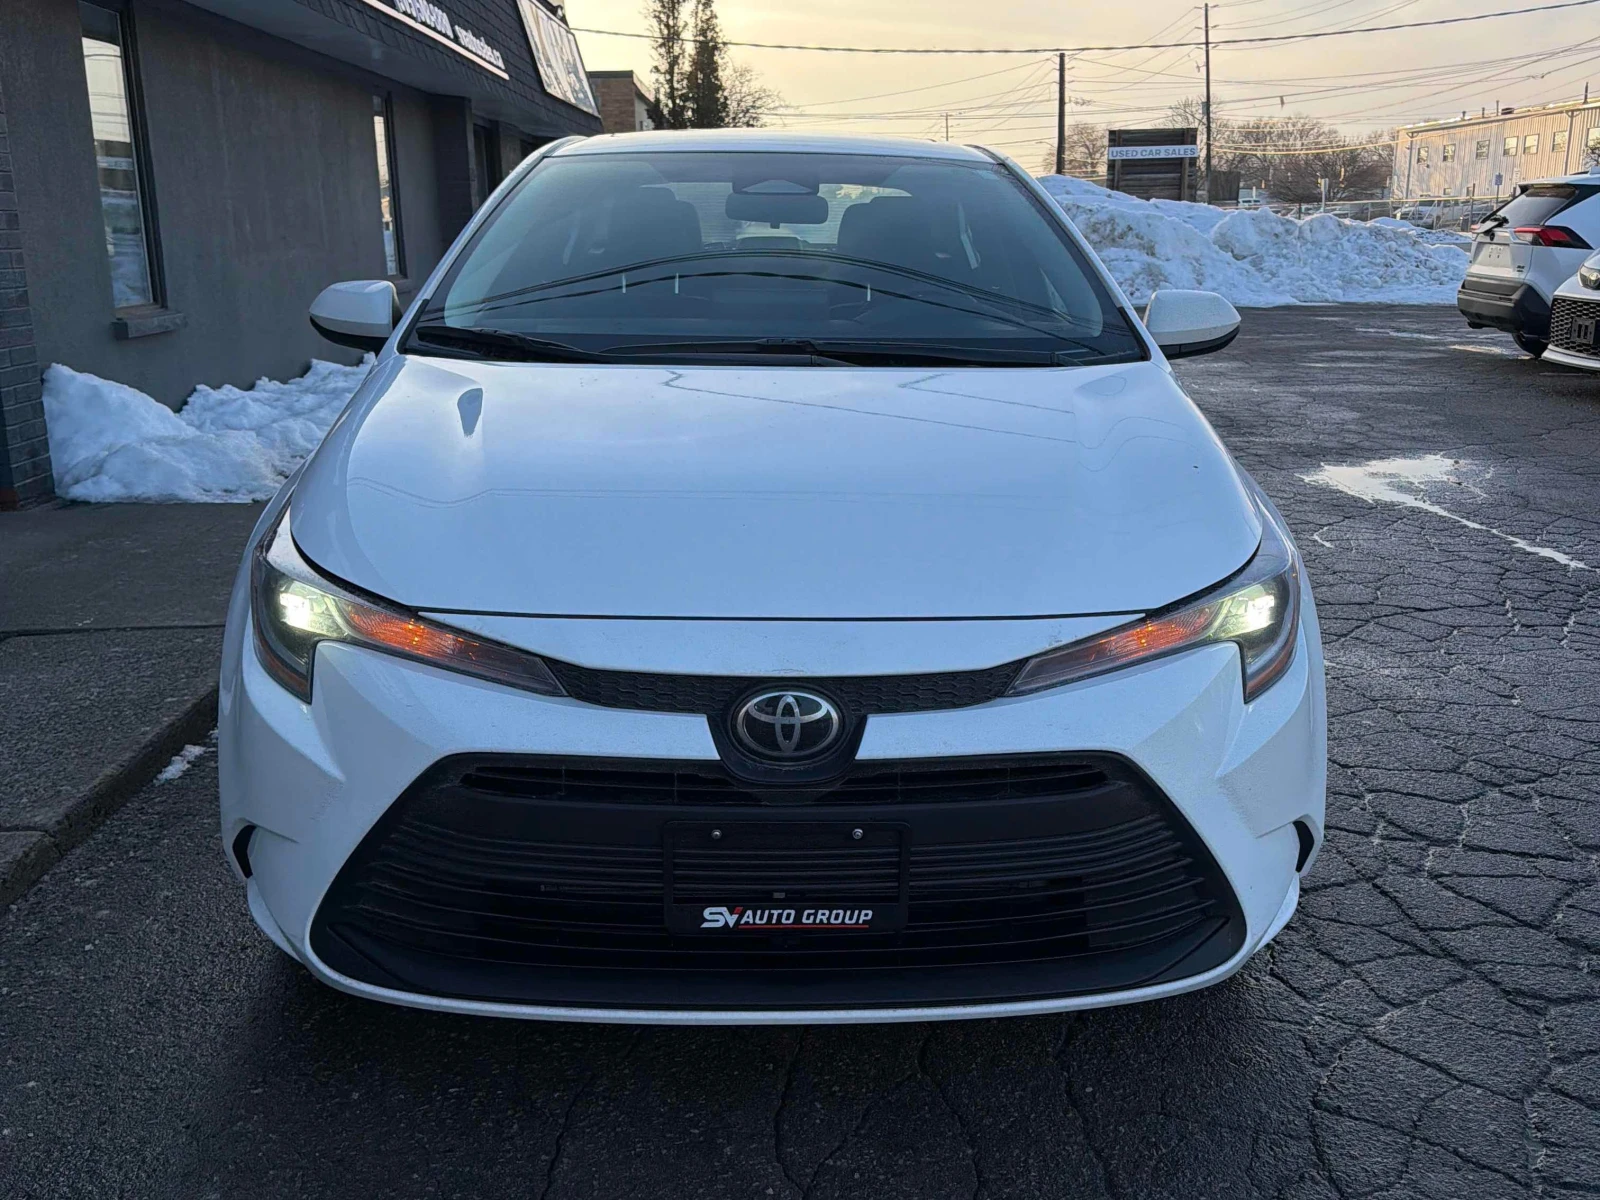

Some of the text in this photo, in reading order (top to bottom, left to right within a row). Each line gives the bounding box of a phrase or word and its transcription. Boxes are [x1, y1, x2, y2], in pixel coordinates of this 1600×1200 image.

[1110, 147, 1196, 158] USED CAR SALES
[740, 909, 796, 925] AUTO
[801, 909, 873, 925] GROUP
